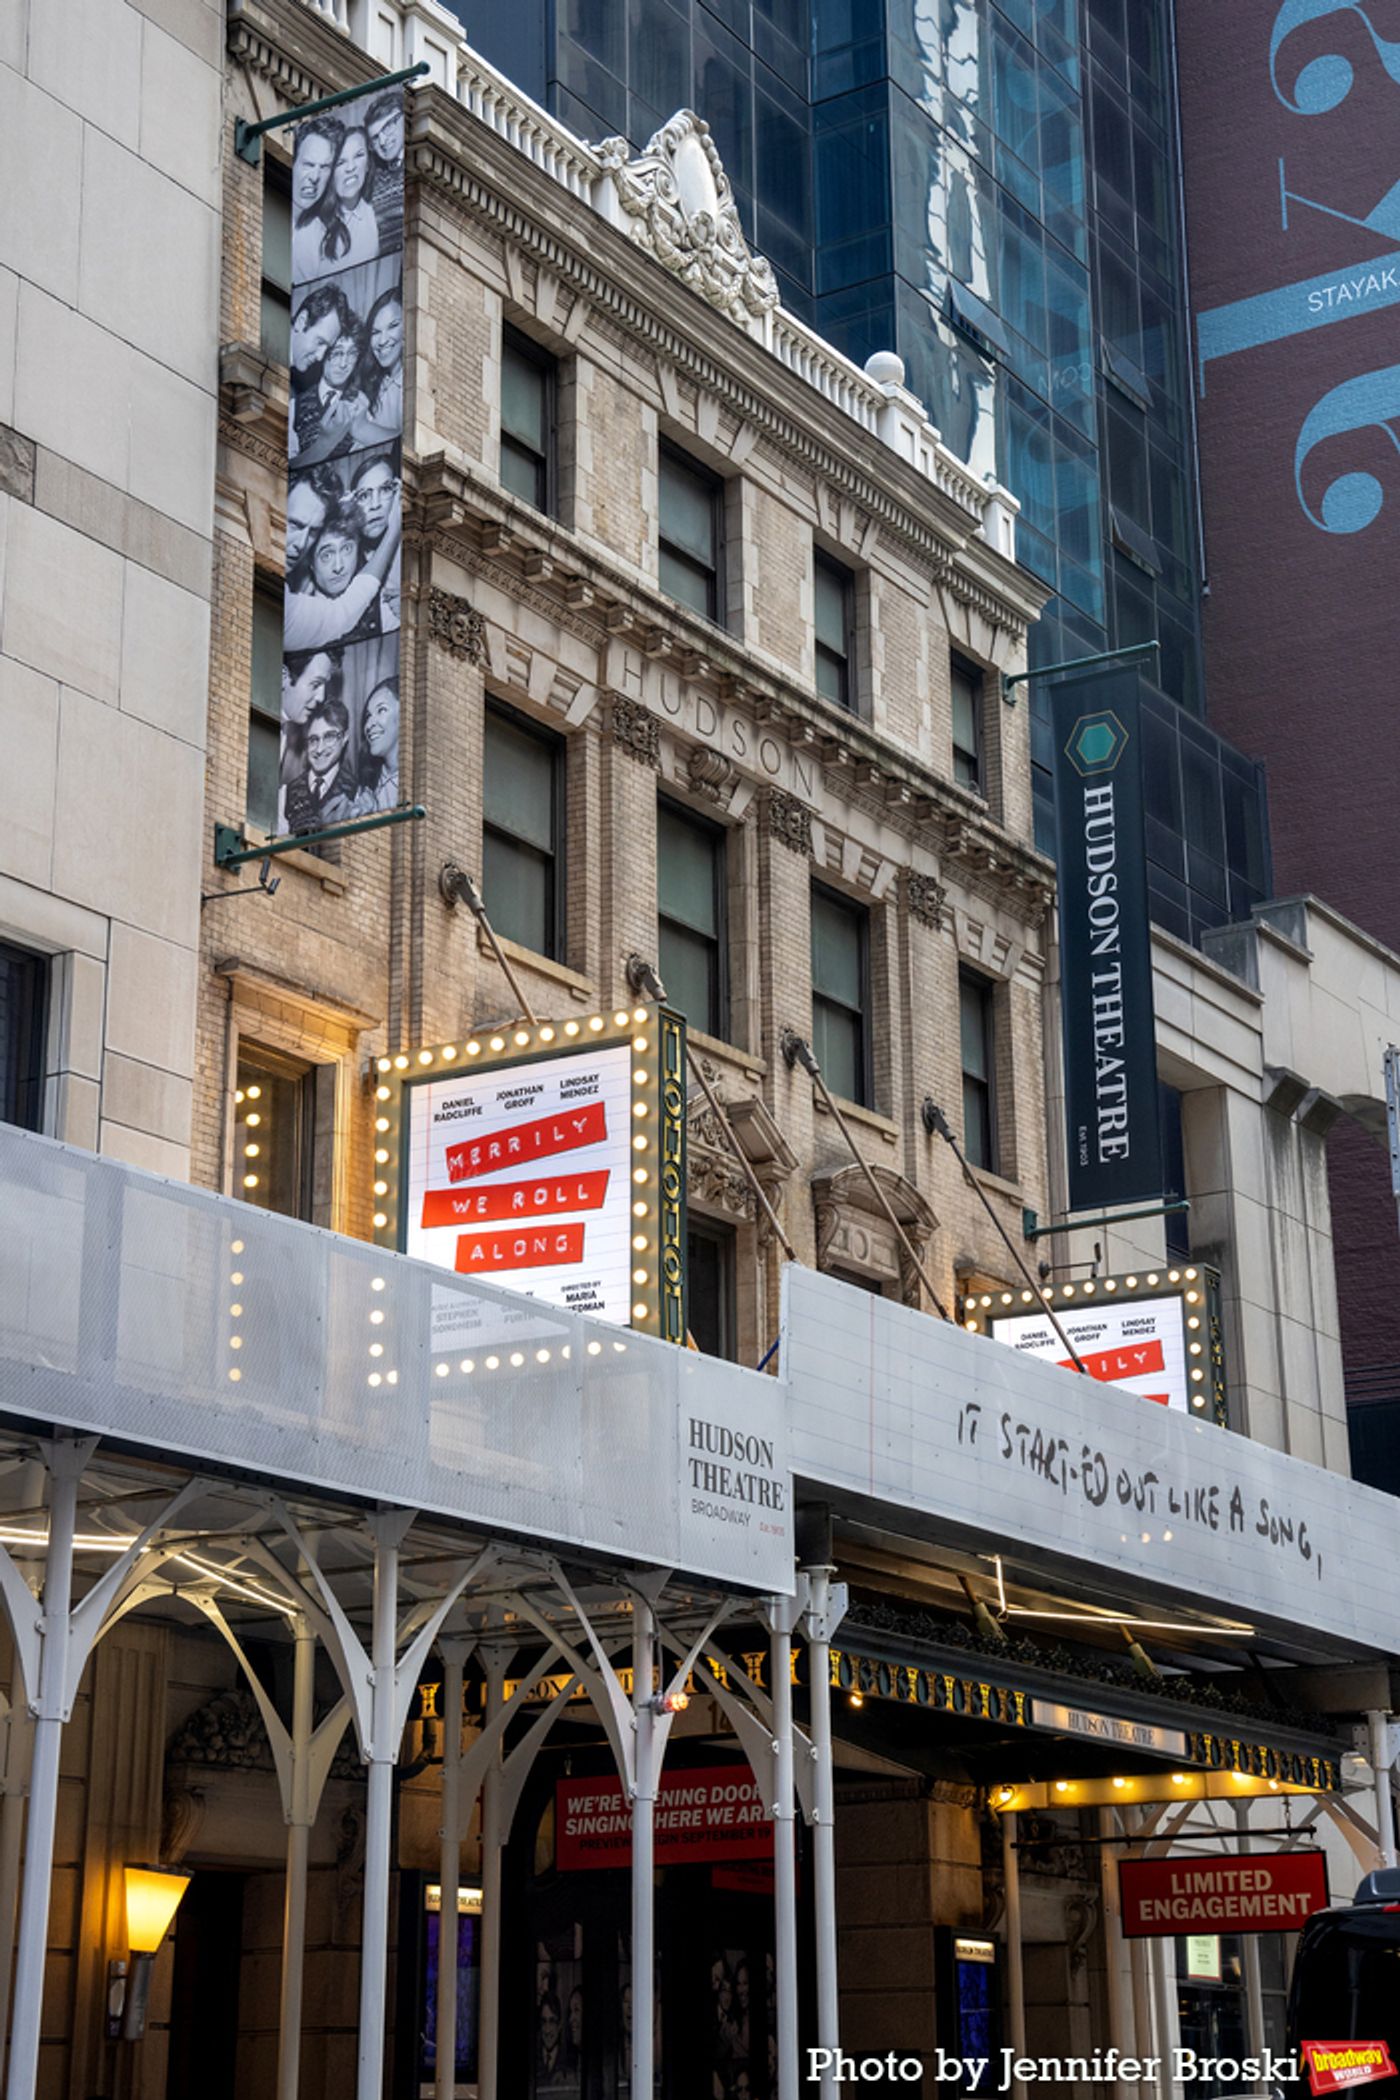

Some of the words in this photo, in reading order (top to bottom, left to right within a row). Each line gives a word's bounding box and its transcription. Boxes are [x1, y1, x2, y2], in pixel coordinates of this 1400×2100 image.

[1308, 268, 1400, 312] STAYAK
[622, 650, 814, 798] HUDSON
[1083, 781, 1121, 956] HUDSON
[1091, 962, 1130, 1163] THEATRE
[560, 1074, 600, 1088] LINDSAY
[560, 1085, 600, 1099] MENDEZ
[496, 1084, 545, 1101] JONATHAN
[504, 1097, 536, 1110] GROFF
[433, 1106, 483, 1123] RADCLIFFE
[442, 1098, 476, 1111] DANIEL
[449, 1117, 588, 1170] MERRILY
[452, 1196, 488, 1213] WE
[512, 1184, 589, 1209] ROLL
[470, 1234, 568, 1260] ALONG
[566, 1290, 597, 1303] MARIA
[1066, 1323, 1108, 1336] JONATHAN
[1121, 1317, 1156, 1328] LINDSAY
[1122, 1326, 1156, 1336] MENDEZ
[1021, 1331, 1048, 1341] DANIEL
[1074, 1333, 1101, 1343] GROFF
[689, 1418, 774, 1469] HUDSON
[958, 1403, 981, 1444] IT
[1117, 1468, 1159, 1514] OUT
[1169, 1486, 1219, 1531] LIKE
[1230, 1485, 1244, 1533] A
[688, 1458, 784, 1511] THEATRE
[692, 1499, 751, 1526] BROADWAY
[567, 1793, 622, 1814] WE'RE
[655, 1809, 704, 1829] HERE
[706, 1806, 736, 1825] WE
[681, 1827, 755, 1843] SEPTEMBER
[1171, 1869, 1273, 1895] LIMITED
[1139, 1893, 1312, 1921] ENGAGEMENT
